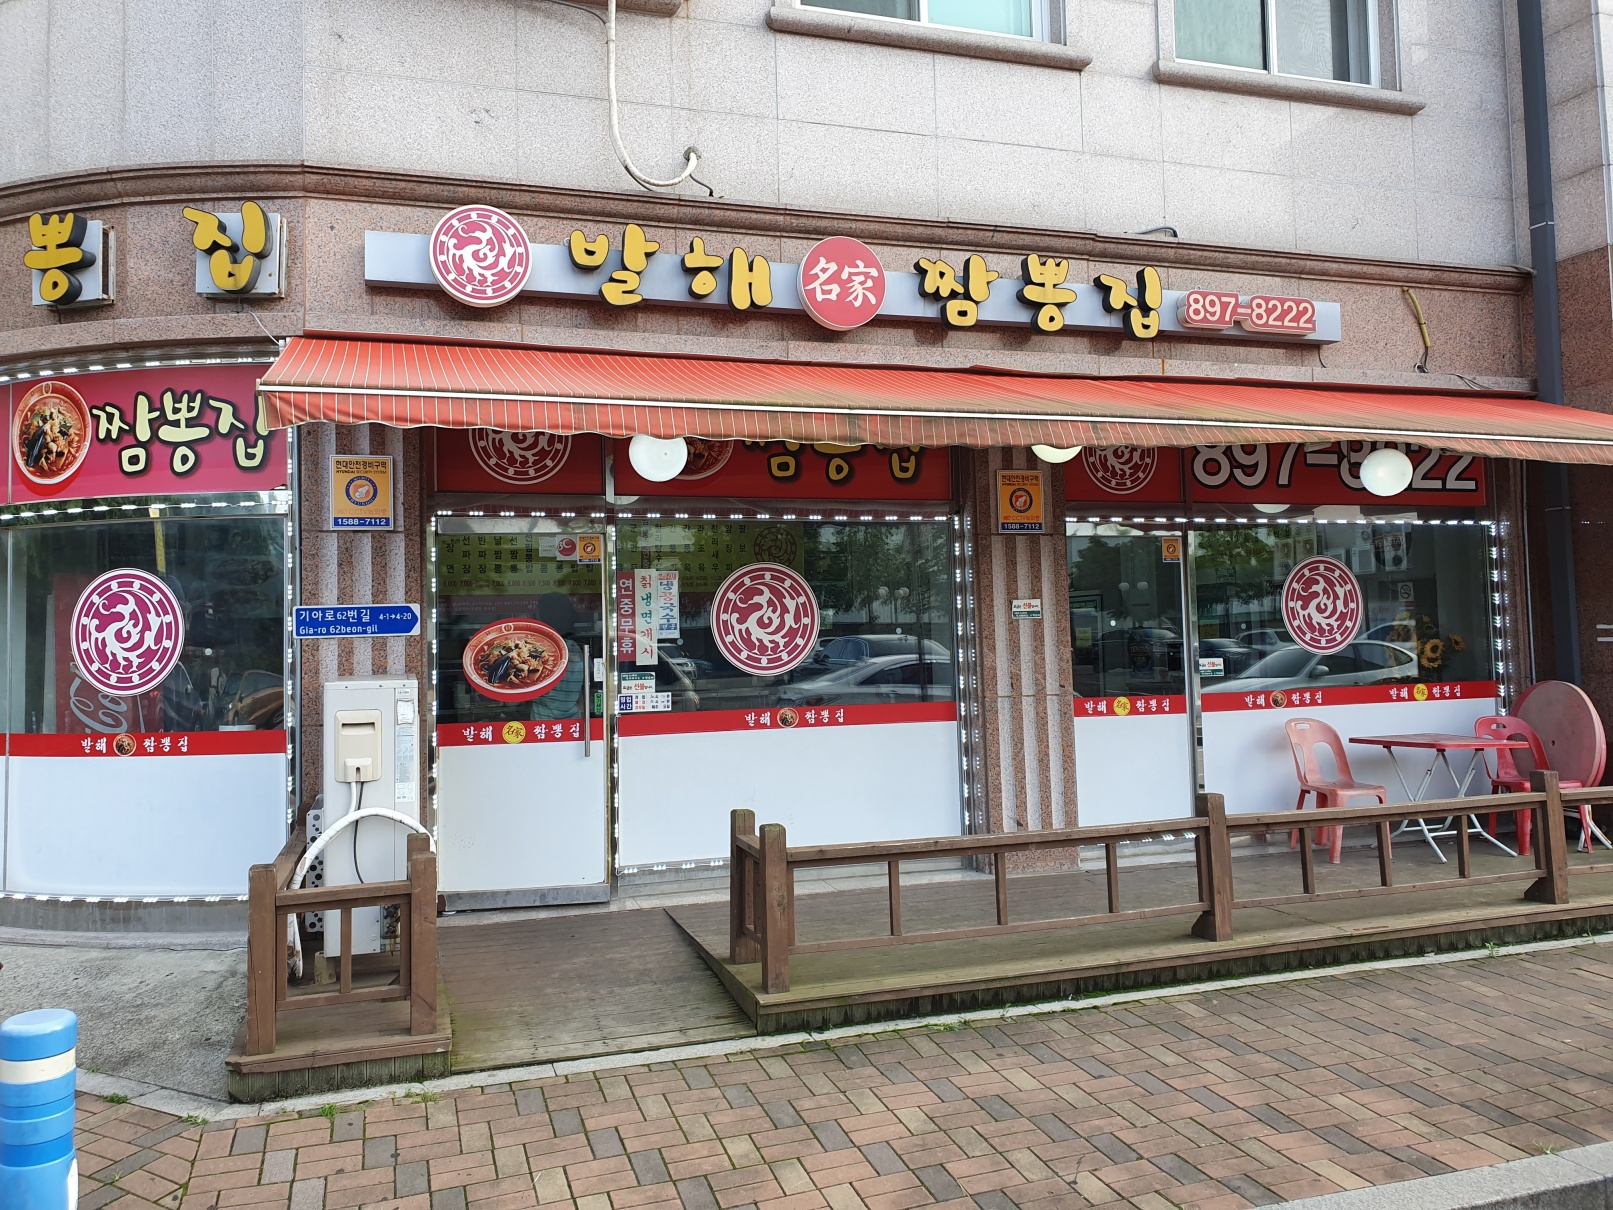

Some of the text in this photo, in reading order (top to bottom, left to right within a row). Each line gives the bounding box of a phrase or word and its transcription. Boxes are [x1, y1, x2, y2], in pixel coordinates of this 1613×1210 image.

[568, 223, 773, 311] 발해
[804, 256, 880, 309] 名家
[913, 253, 1162, 340] 짬뽕집
[1188, 293, 1313, 328] 897-8222
[92, 386, 270, 476] 짬뽕집
[335, 460, 387, 470] 현대안전경비구역
[1192, 442, 1477, 490] 897-822
[619, 578, 634, 654] 연중무휴
[299, 624, 378, 635] Gia-ro 62beon-gil
[1244, 691, 1323, 707] 발해 짬뽕집
[1388, 687, 1409, 700] 발해
[1432, 685, 1461, 698] 짬뽕집
[1084, 700, 1107, 714] 발해
[1136, 698, 1170, 713] 짬뽕집
[744, 709, 845, 726] 발해 짬뽕집
[462, 728, 493, 742] 발해
[503, 724, 524, 740] 名家
[533, 722, 580, 740] 짬뽕집
[81, 736, 188, 753] 발해 짬뽕집
